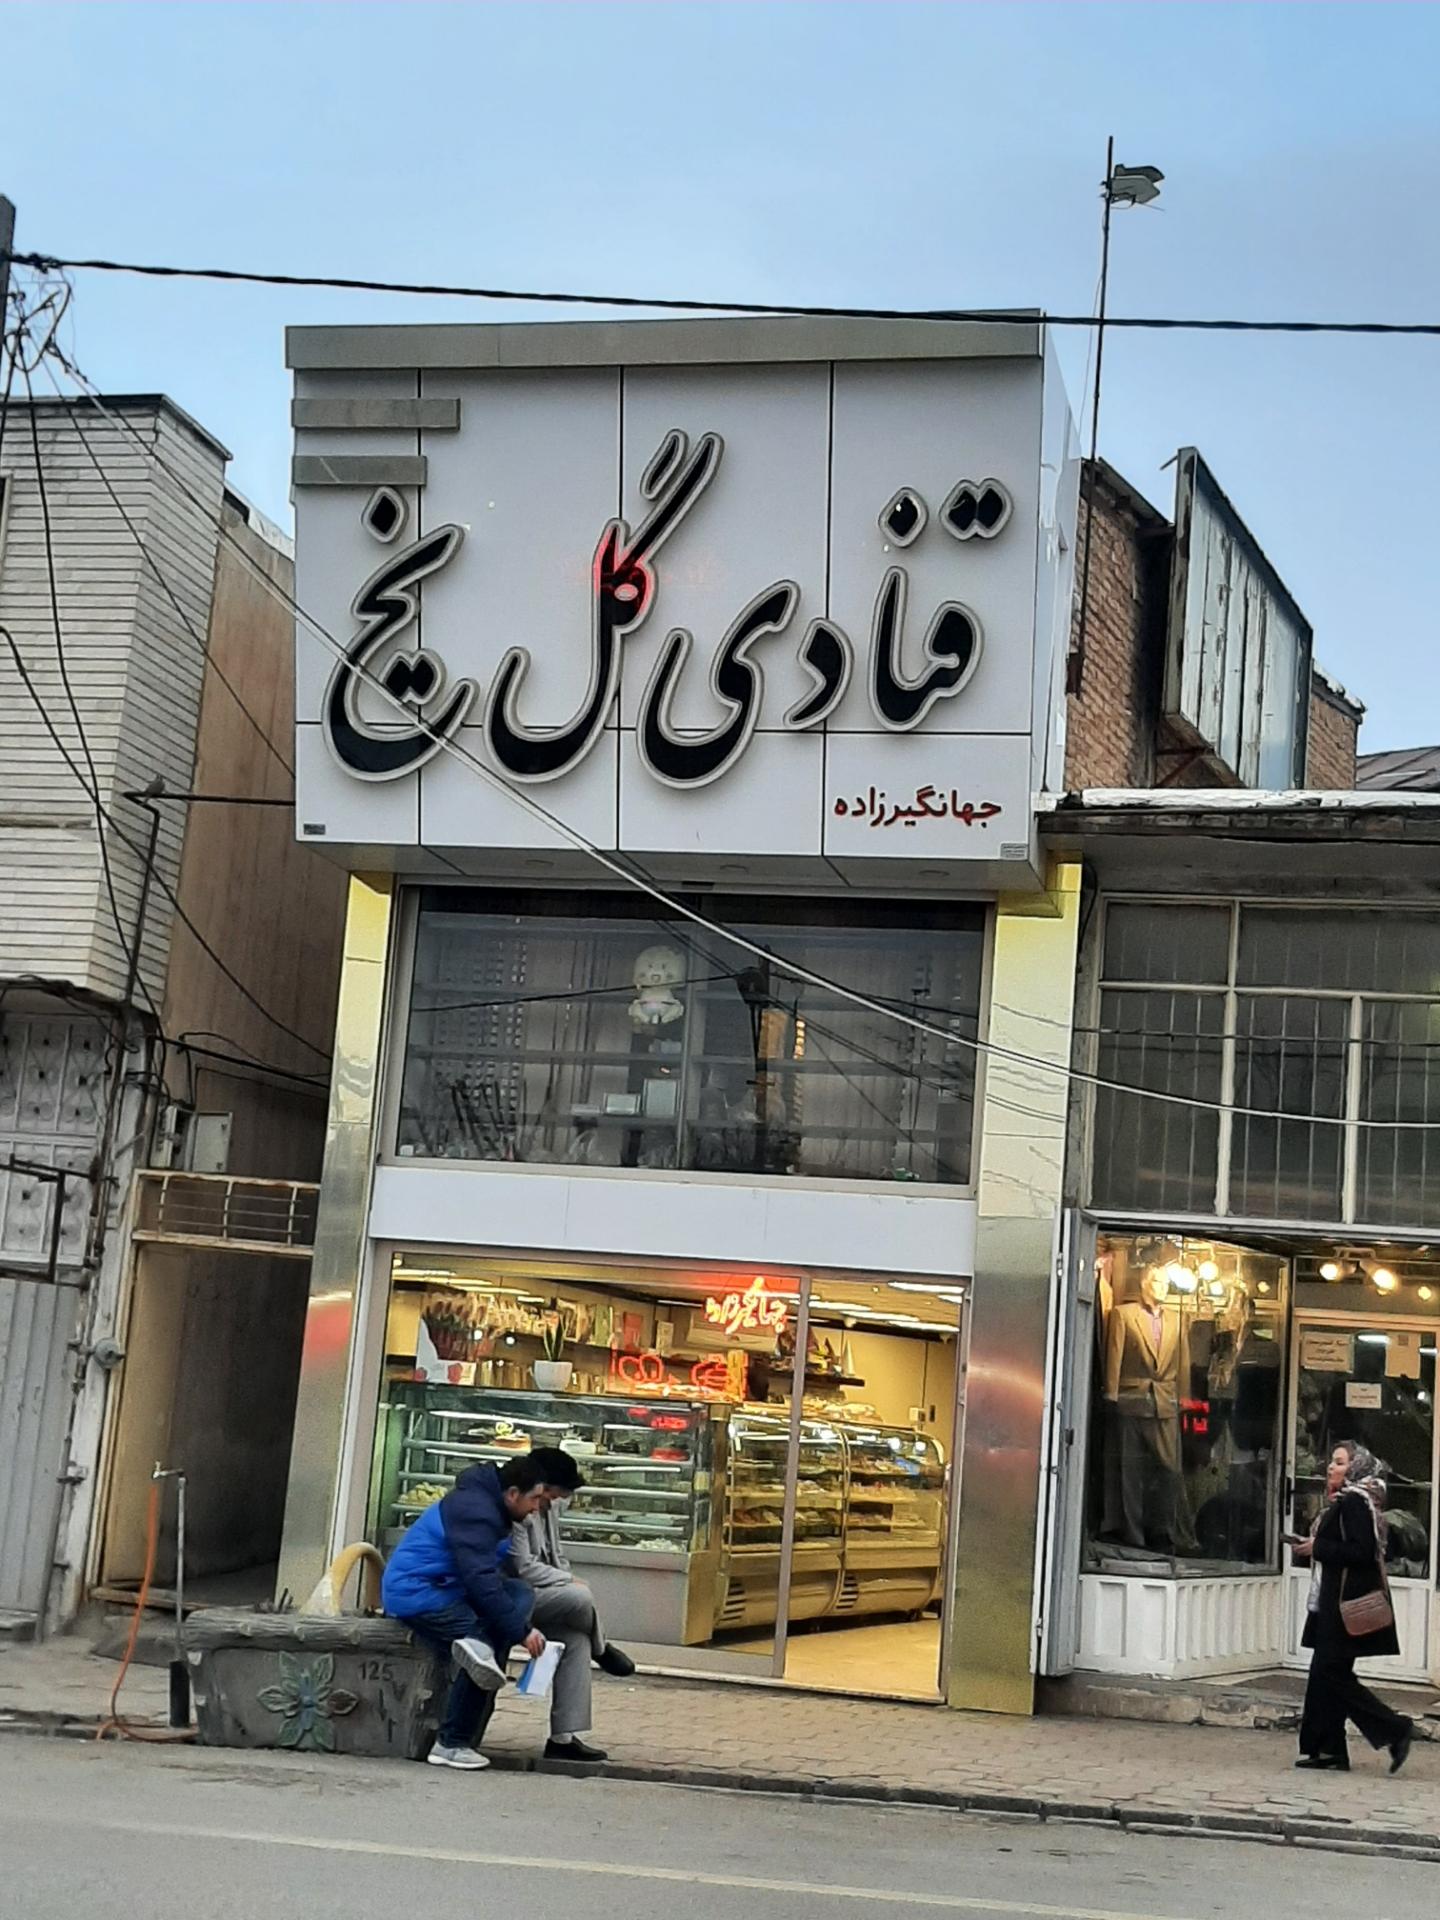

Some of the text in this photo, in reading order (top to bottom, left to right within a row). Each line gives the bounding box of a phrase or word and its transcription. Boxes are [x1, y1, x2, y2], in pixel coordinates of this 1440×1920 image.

[322, 429, 1012, 789] قنادی گل یخ
[834, 785, 1002, 828] جهانگیرزاده
[359, 1661, 394, 1681] 125
